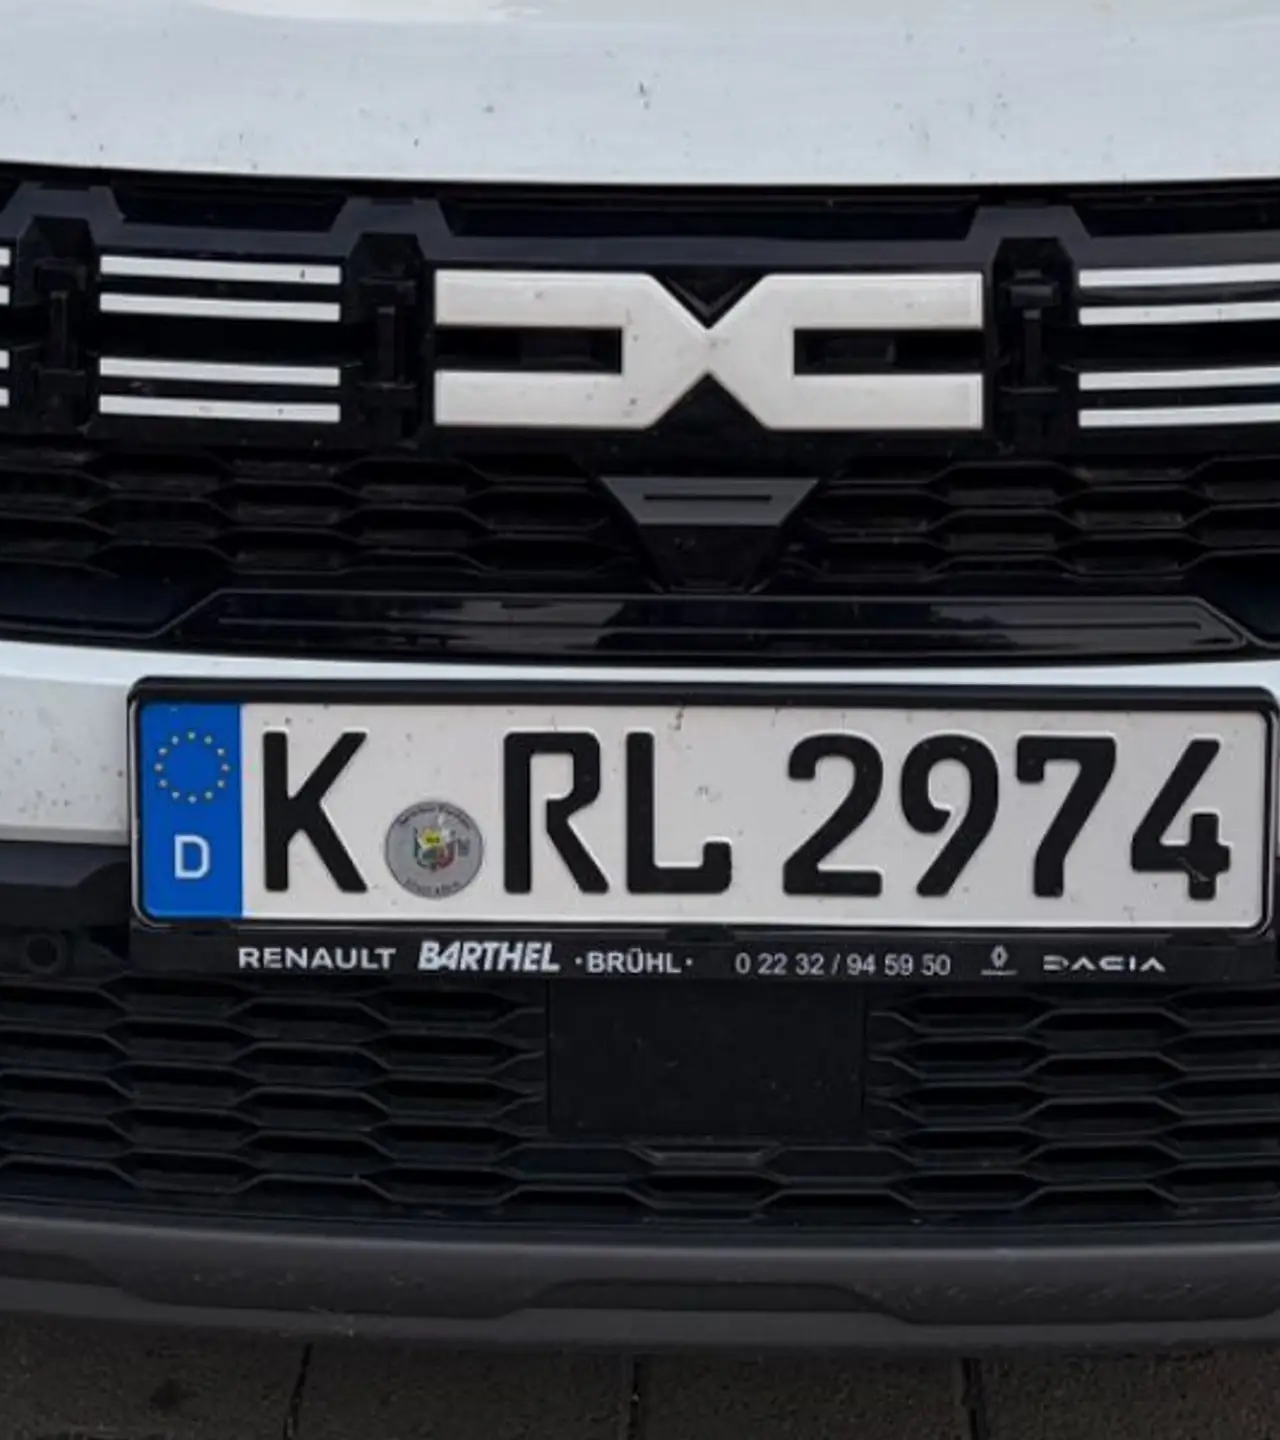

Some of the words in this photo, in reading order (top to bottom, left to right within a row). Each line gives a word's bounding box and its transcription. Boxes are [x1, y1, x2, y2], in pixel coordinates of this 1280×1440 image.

[261, 731, 369, 894] K
[503, 732, 733, 895] RL
[782, 734, 1231, 901] 2974
[174, 834, 210, 879] D
[237, 946, 398, 970] RENAULT
[417, 940, 562, 972] BARTHEL
[734, 951, 752, 975] 0
[757, 952, 788, 975] 22
[795, 952, 826, 975] 32
[845, 953, 877, 976] 94
[884, 953, 915, 976] 59
[921, 953, 952, 977] 50
[1042, 955, 1166, 972] DACIA
